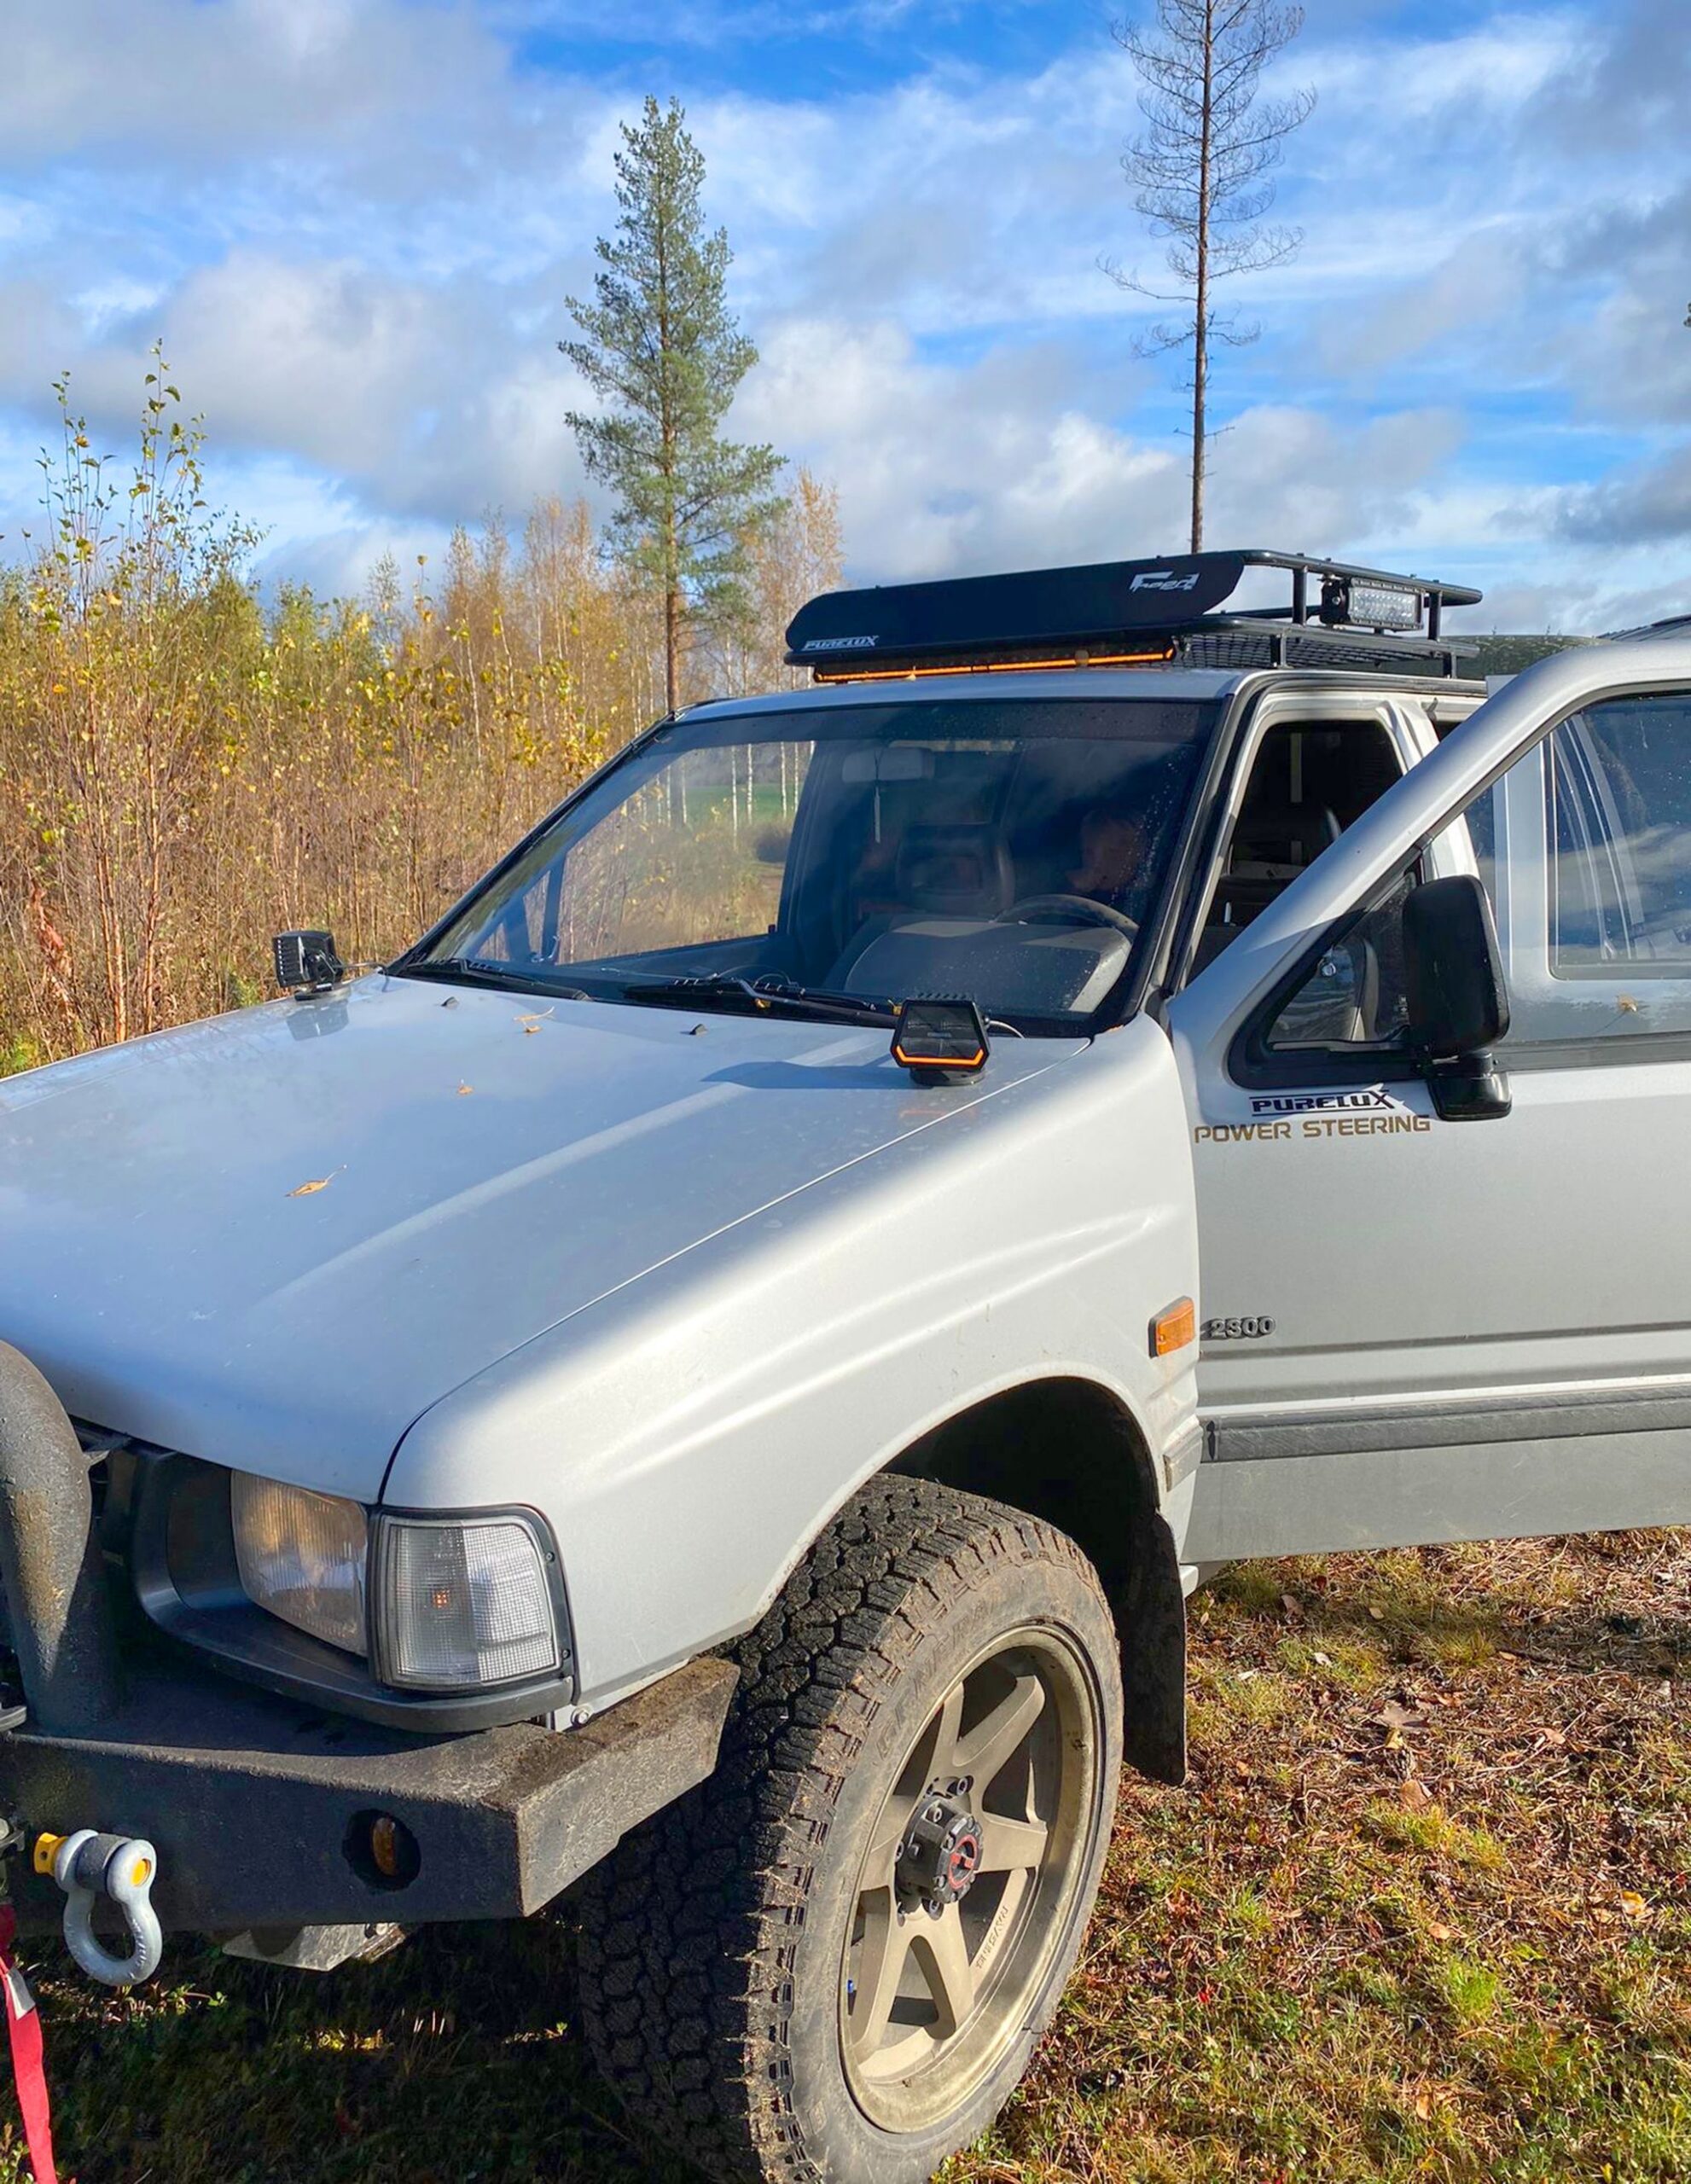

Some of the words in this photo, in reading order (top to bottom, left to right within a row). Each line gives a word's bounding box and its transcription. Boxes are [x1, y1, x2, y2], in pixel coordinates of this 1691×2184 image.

[1251, 1089, 1395, 1113] PURELUX
[1194, 1122, 1292, 1144] POWER
[1302, 1114, 1431, 1138] STEERING
